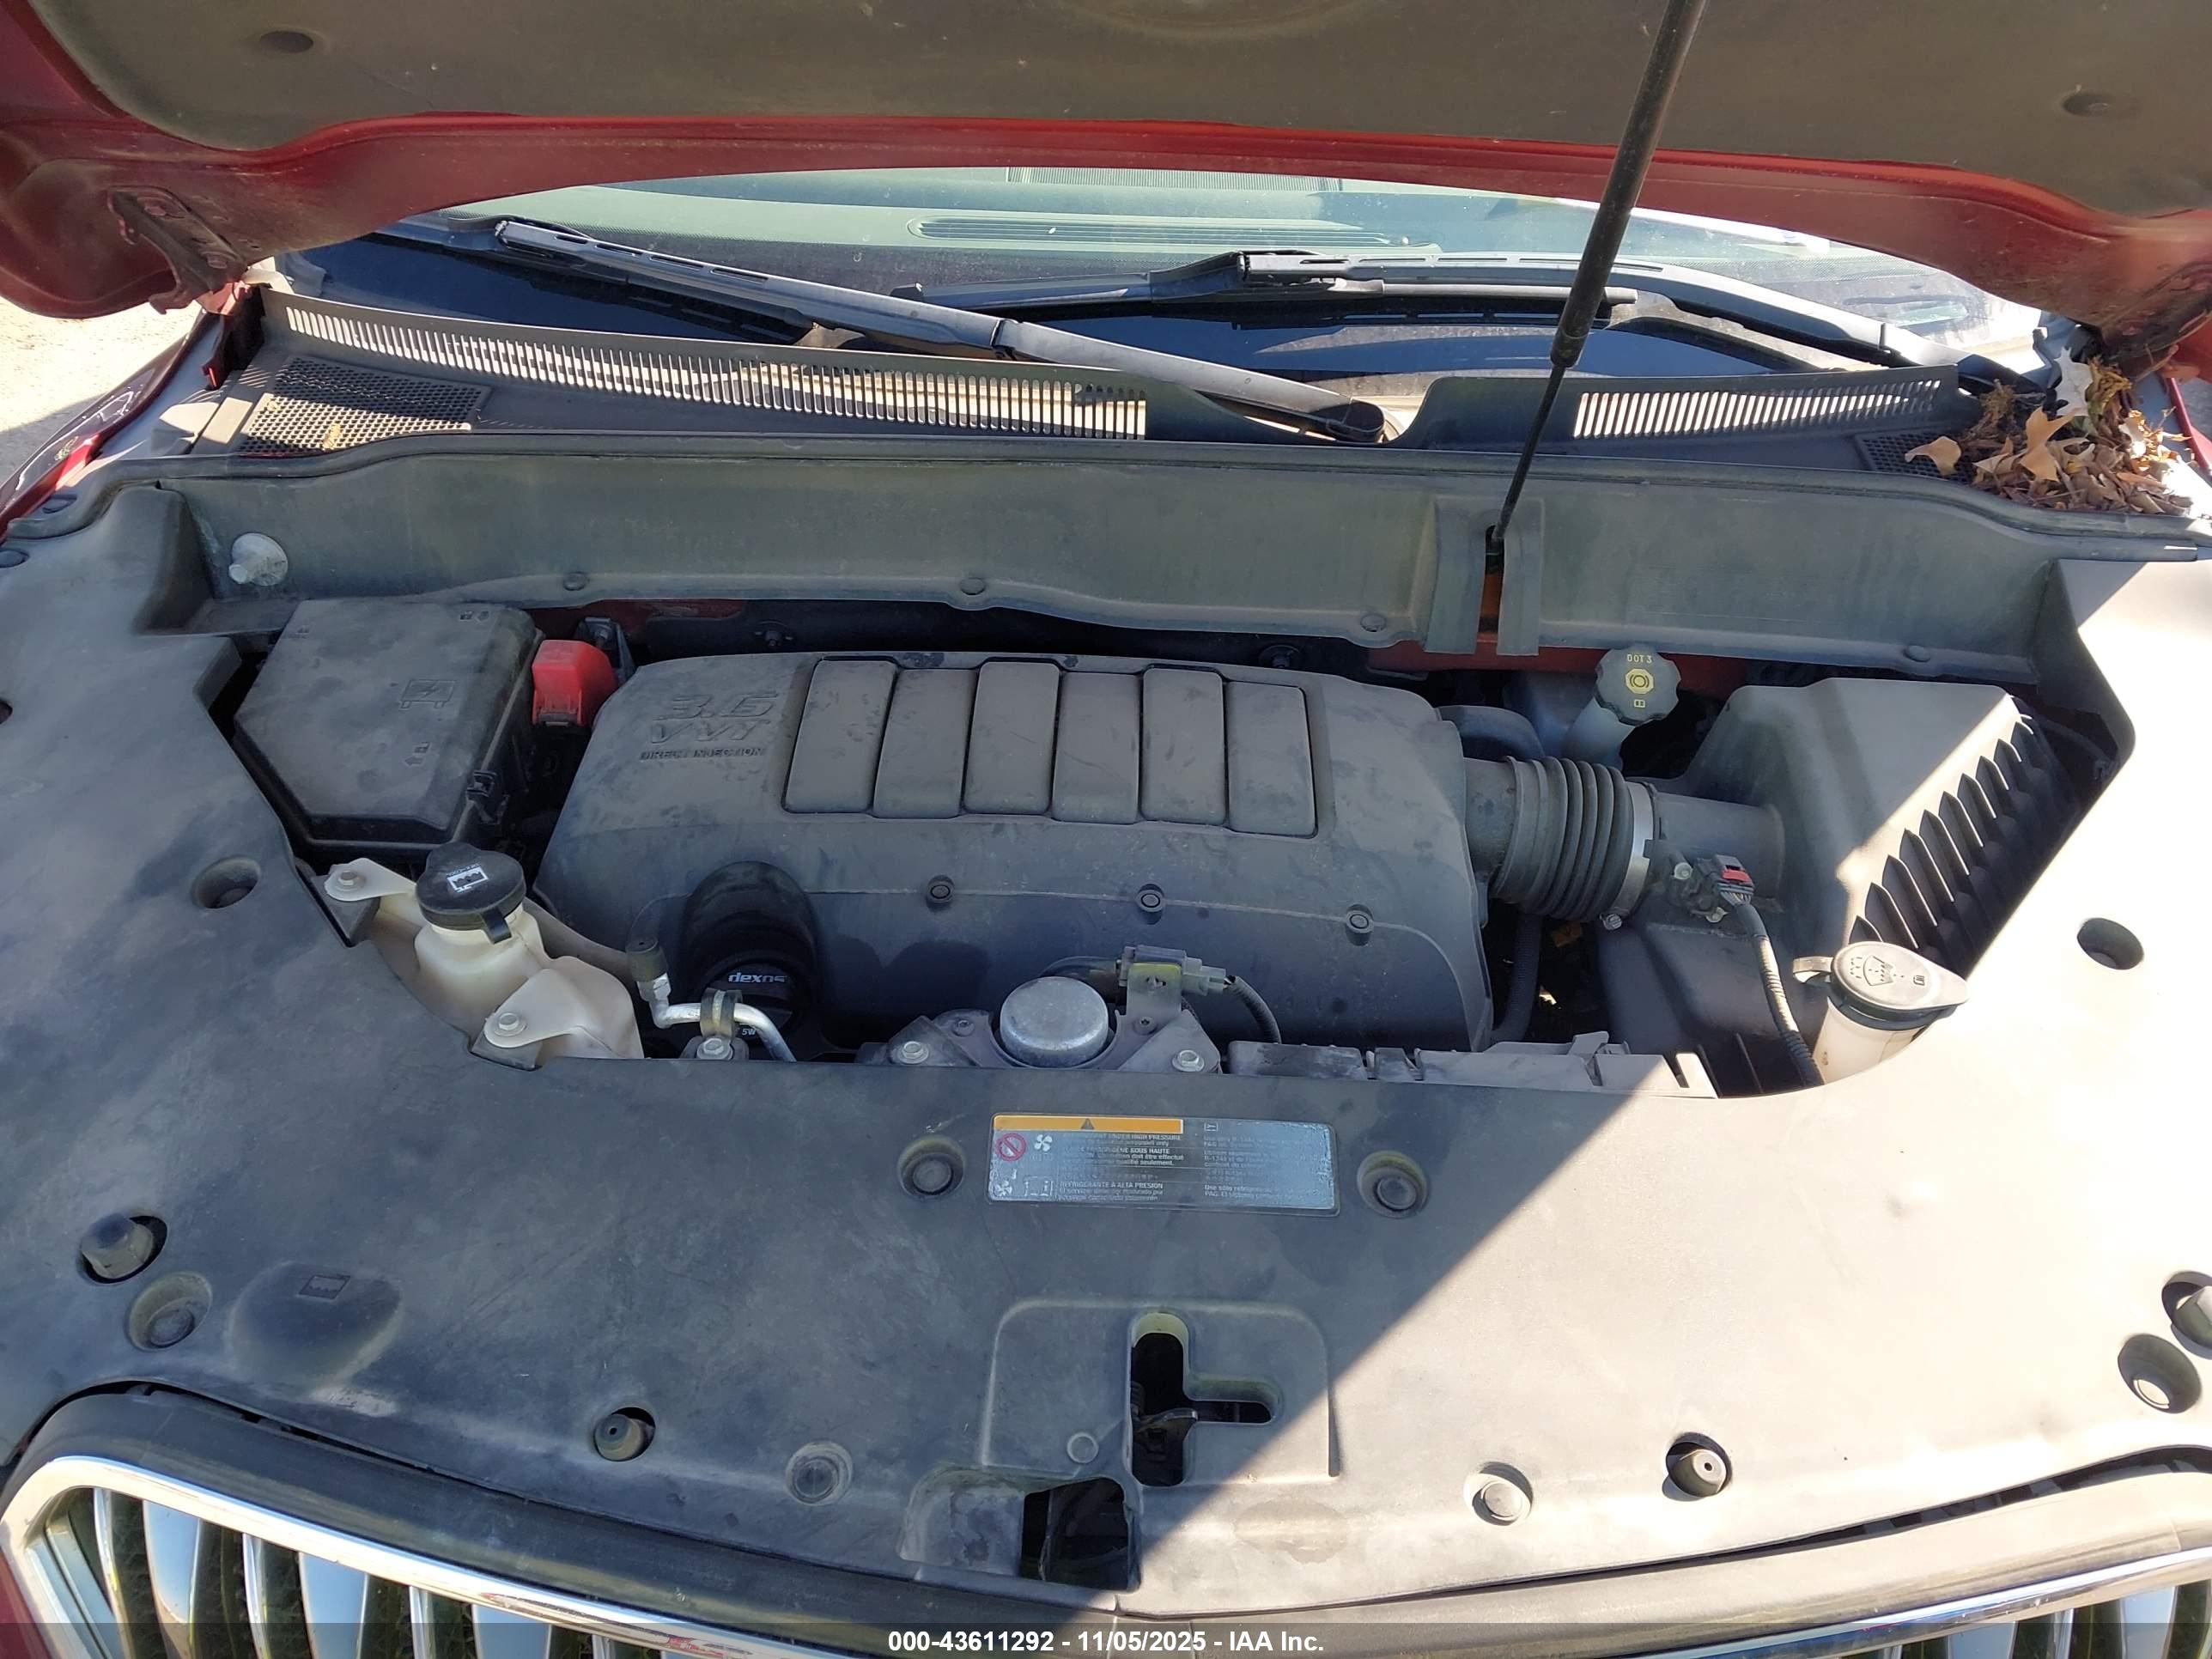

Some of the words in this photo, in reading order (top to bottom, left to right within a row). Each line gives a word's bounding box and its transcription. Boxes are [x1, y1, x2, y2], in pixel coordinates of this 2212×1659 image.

[1627, 654, 1644, 663] DOT
[1646, 655, 1652, 664] 3
[653, 690, 779, 720] 3.6
[650, 719, 771, 744] VVT
[640, 749, 687, 761] DIRECT
[693, 747, 764, 758] INJECTION
